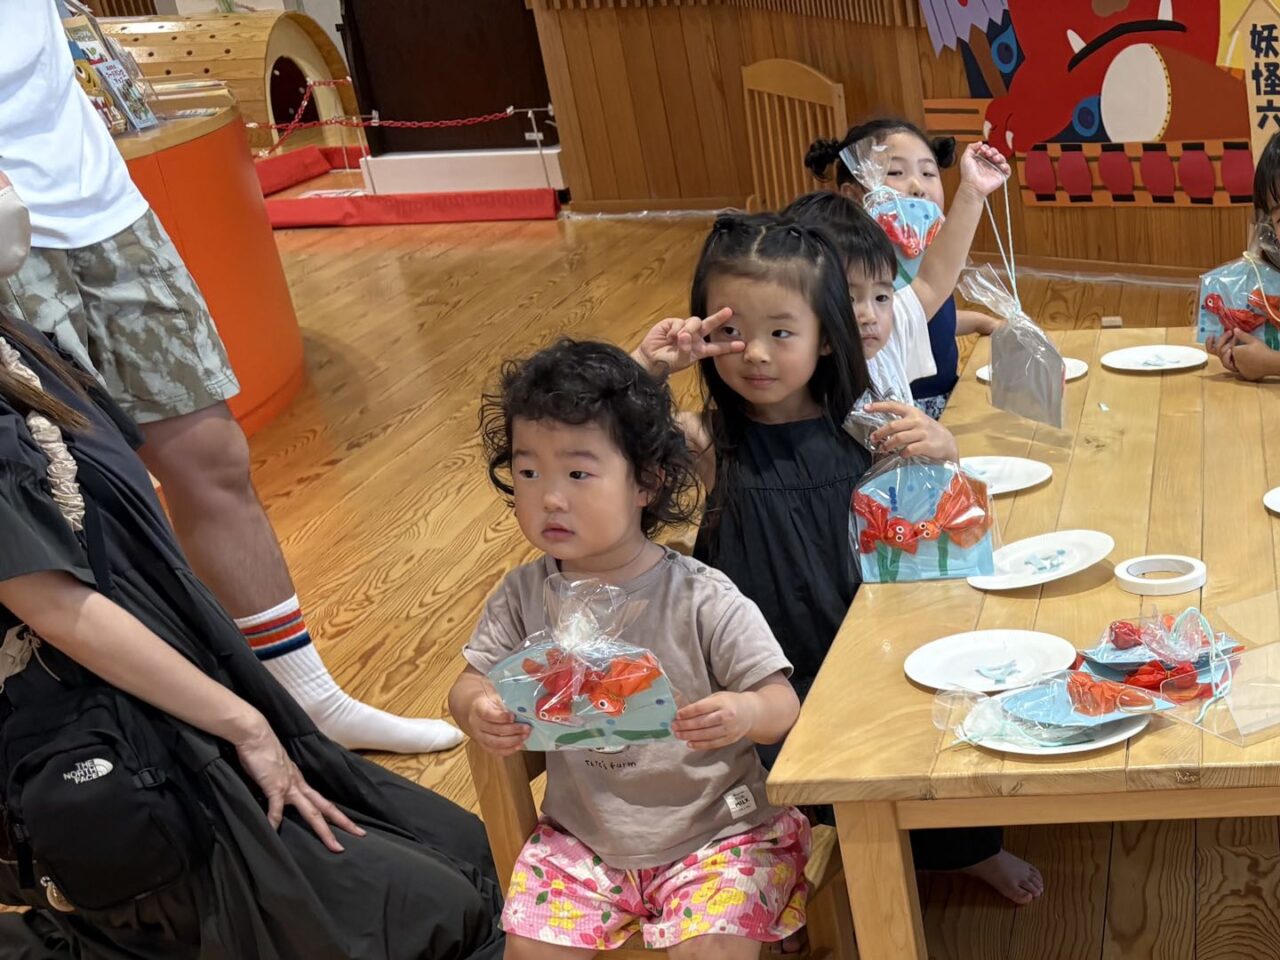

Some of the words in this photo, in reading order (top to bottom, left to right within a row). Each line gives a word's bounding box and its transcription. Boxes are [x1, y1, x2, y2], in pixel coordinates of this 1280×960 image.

[75, 760, 95, 771] THE
[63, 765, 98, 781] NORTH
[74, 771, 99, 785] FACE
